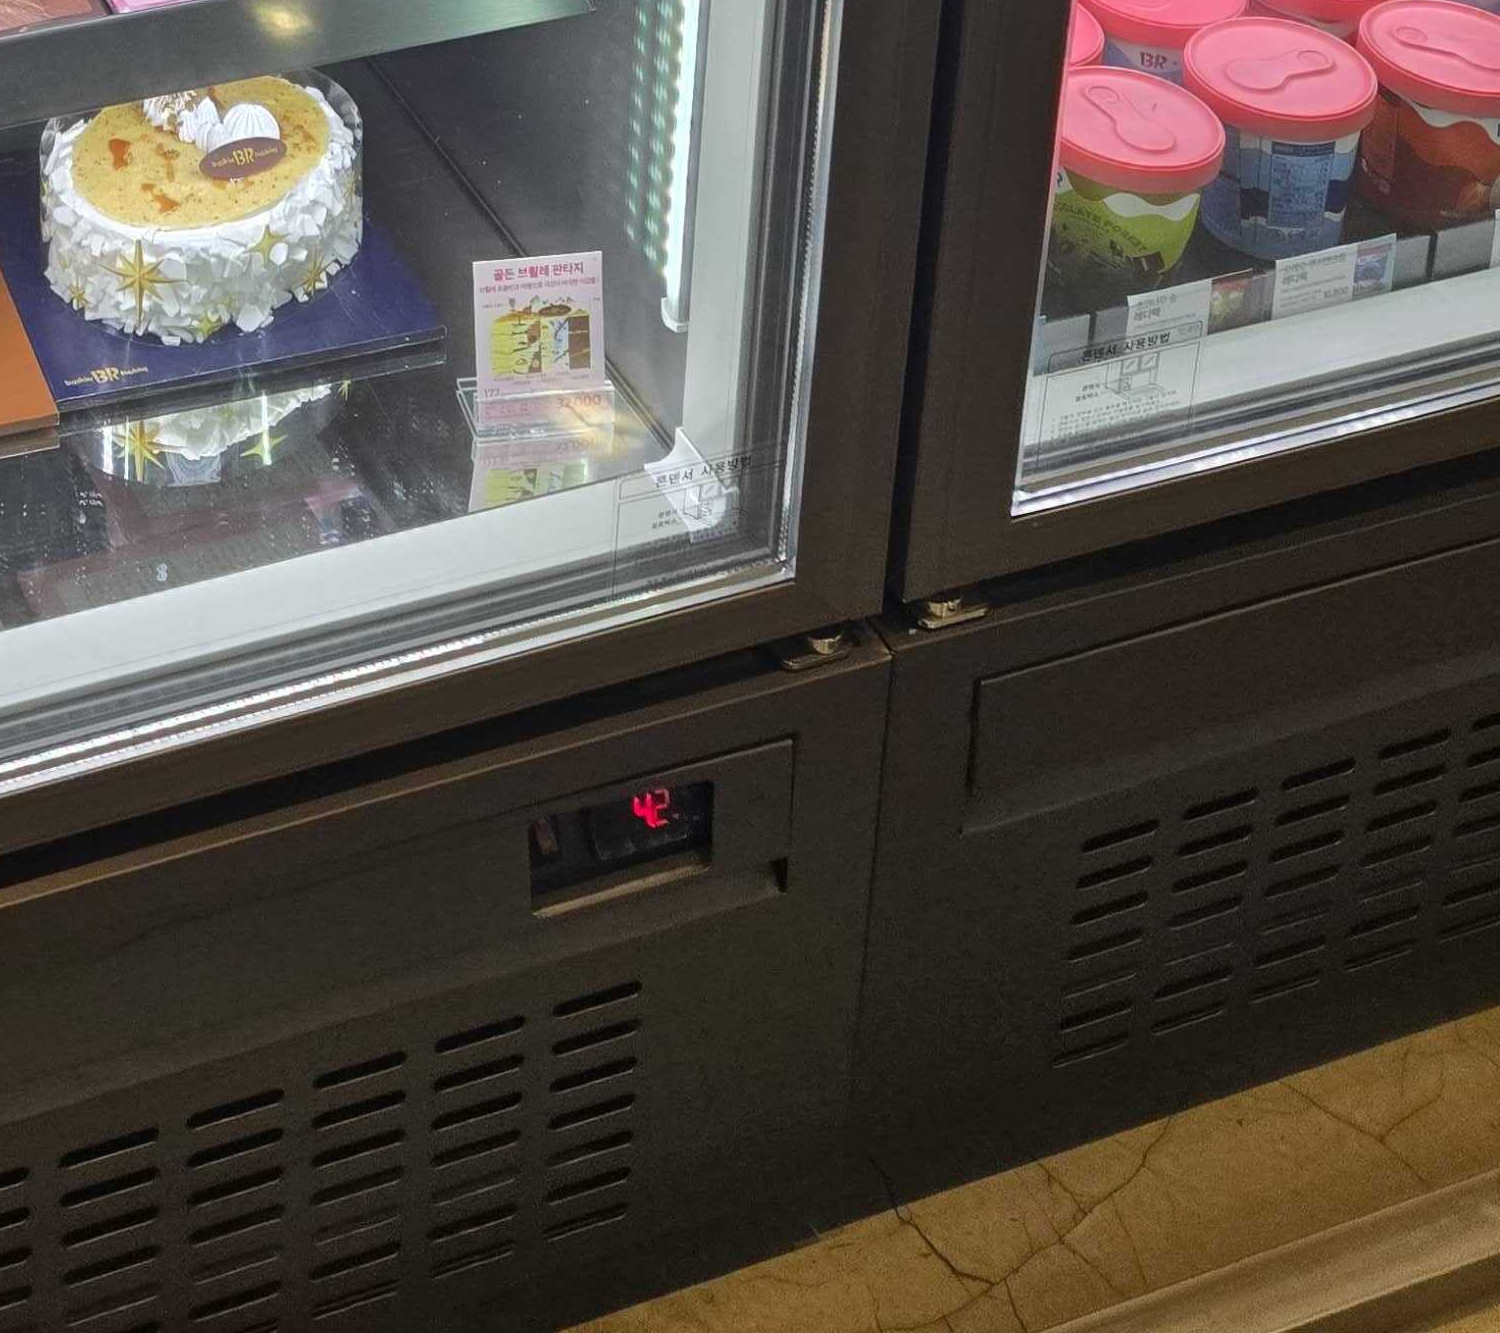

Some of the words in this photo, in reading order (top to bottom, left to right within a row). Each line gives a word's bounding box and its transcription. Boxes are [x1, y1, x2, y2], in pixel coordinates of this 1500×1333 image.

[1140, 52, 1168, 69] BR
[232, 147, 255, 165] BR
[553, 261, 584, 275] 판타지
[1123, 332, 1171, 353] 사용방법
[91, 367, 119, 383] BR
